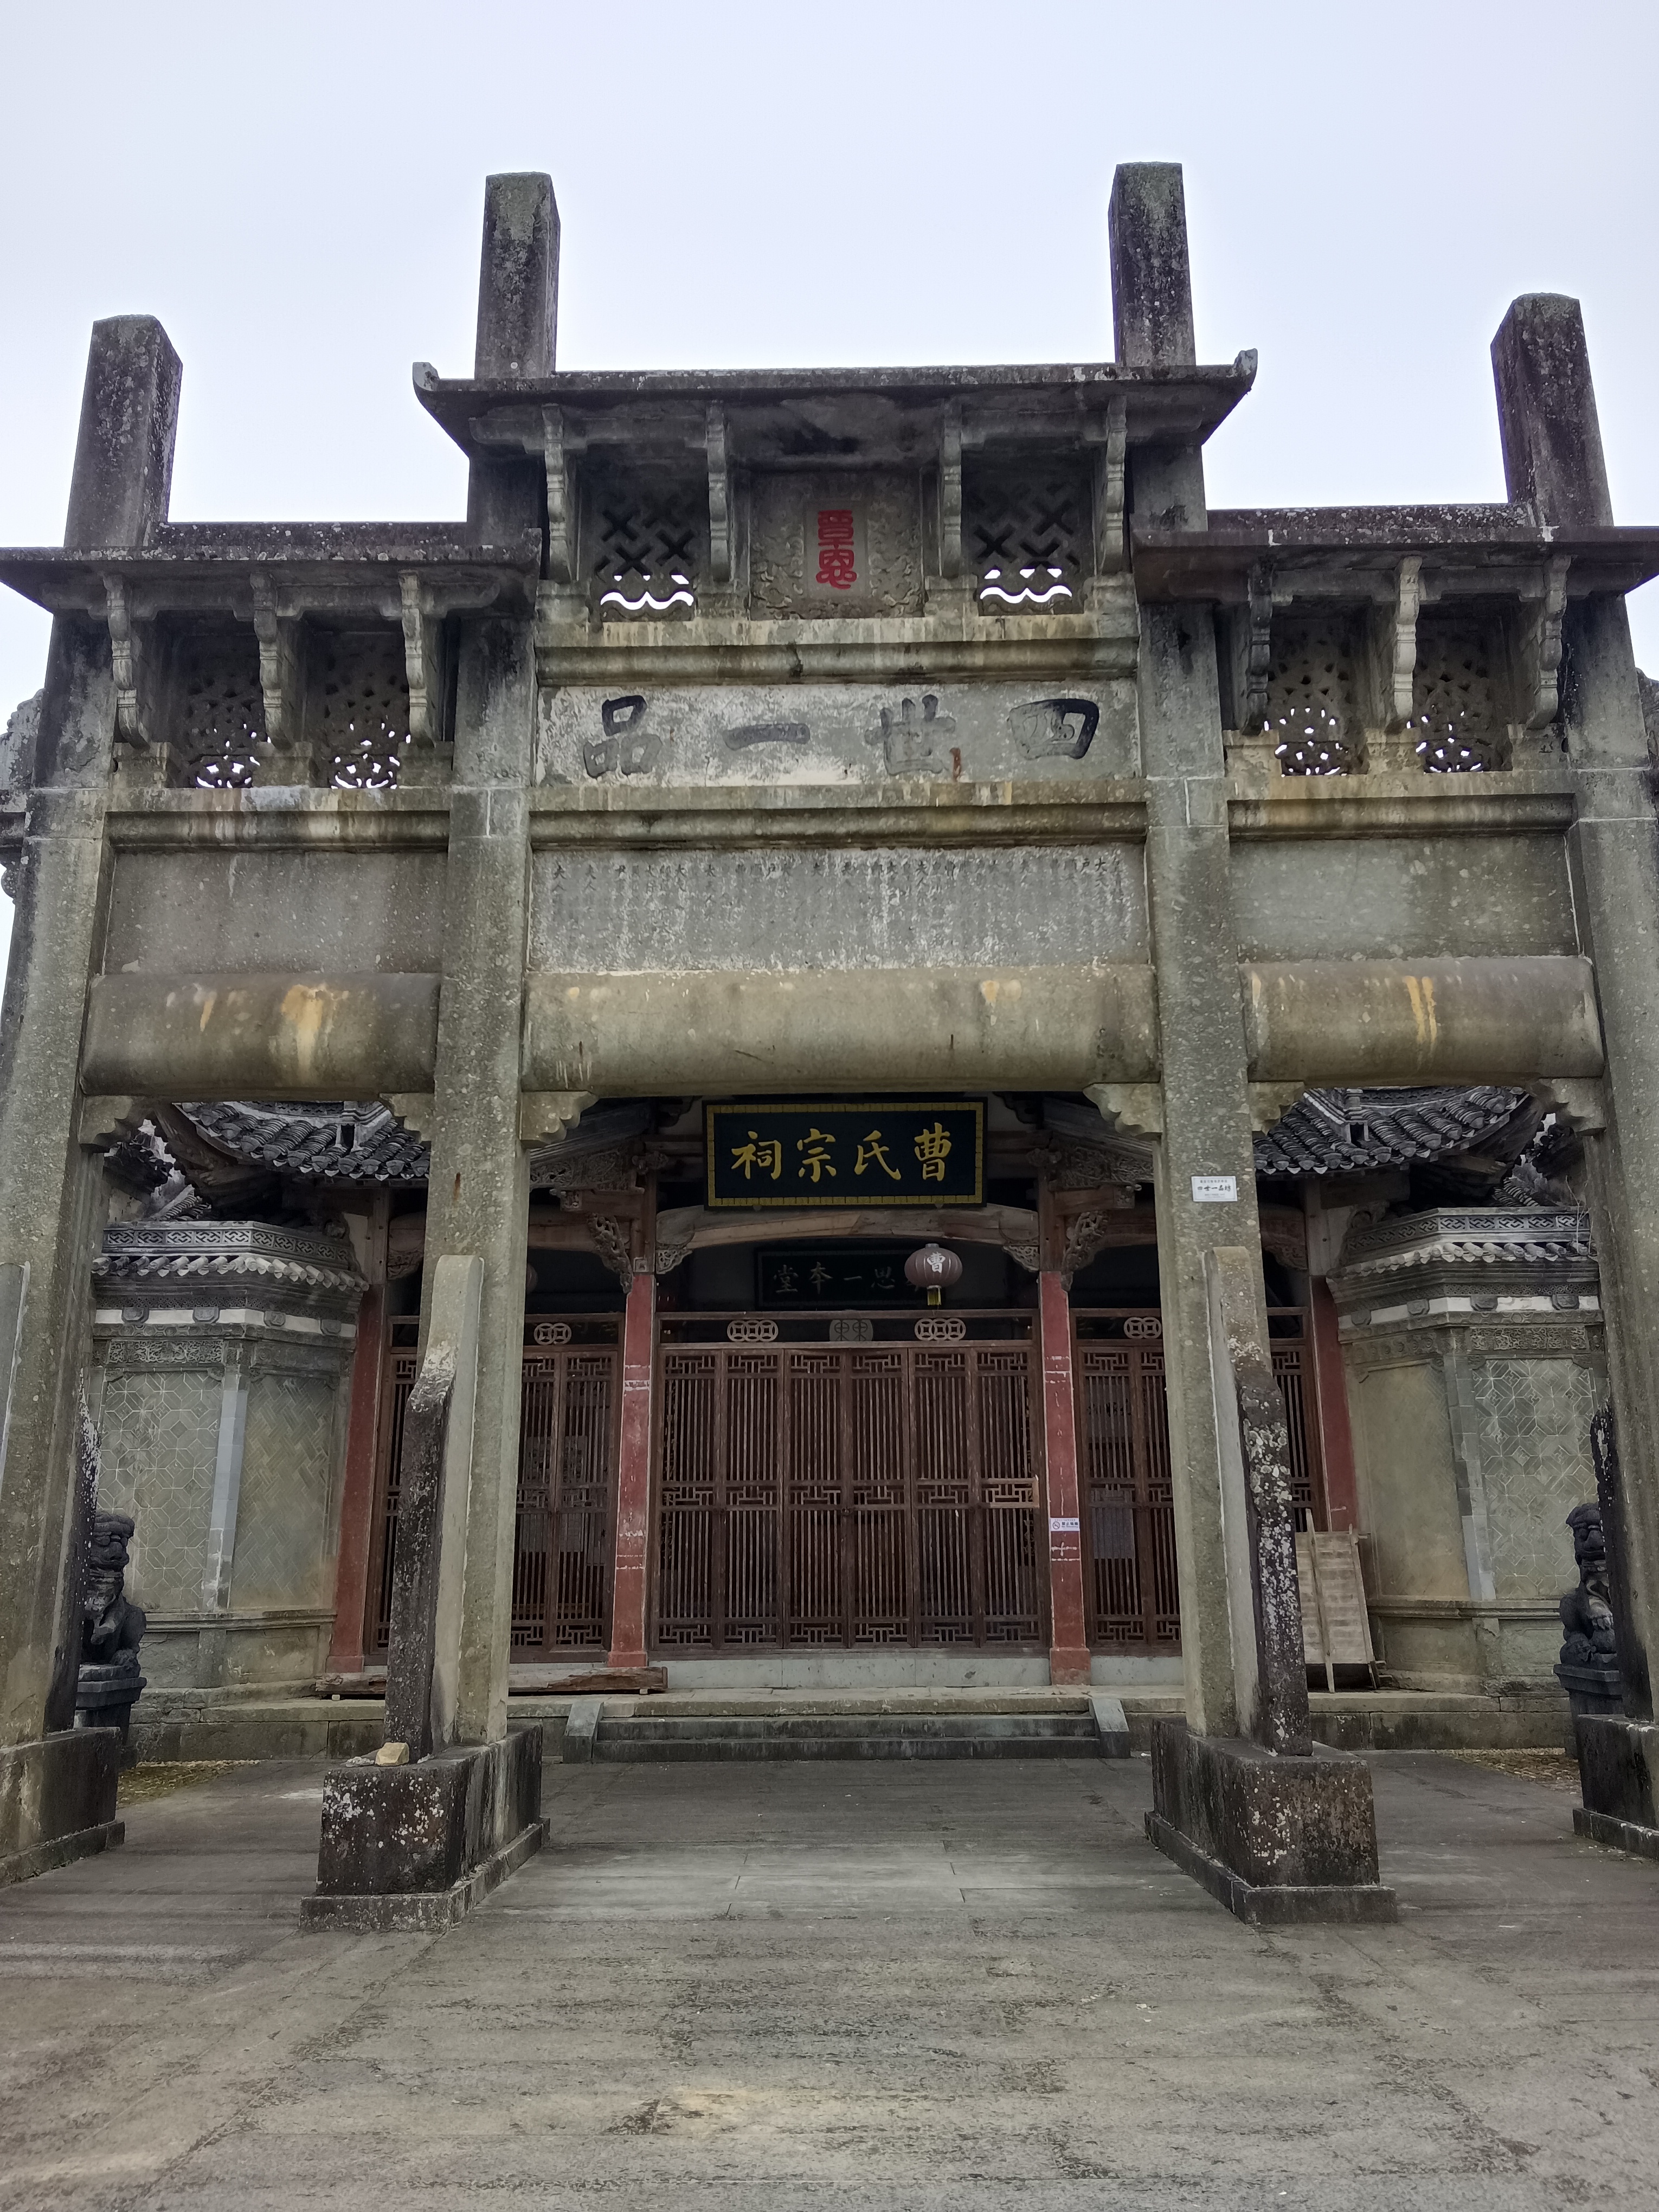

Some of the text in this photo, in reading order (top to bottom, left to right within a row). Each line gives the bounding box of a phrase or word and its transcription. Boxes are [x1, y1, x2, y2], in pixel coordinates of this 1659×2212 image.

[730, 1122, 953, 1183] 曹氏宗祠
[927, 1251, 946, 1274] 曹
